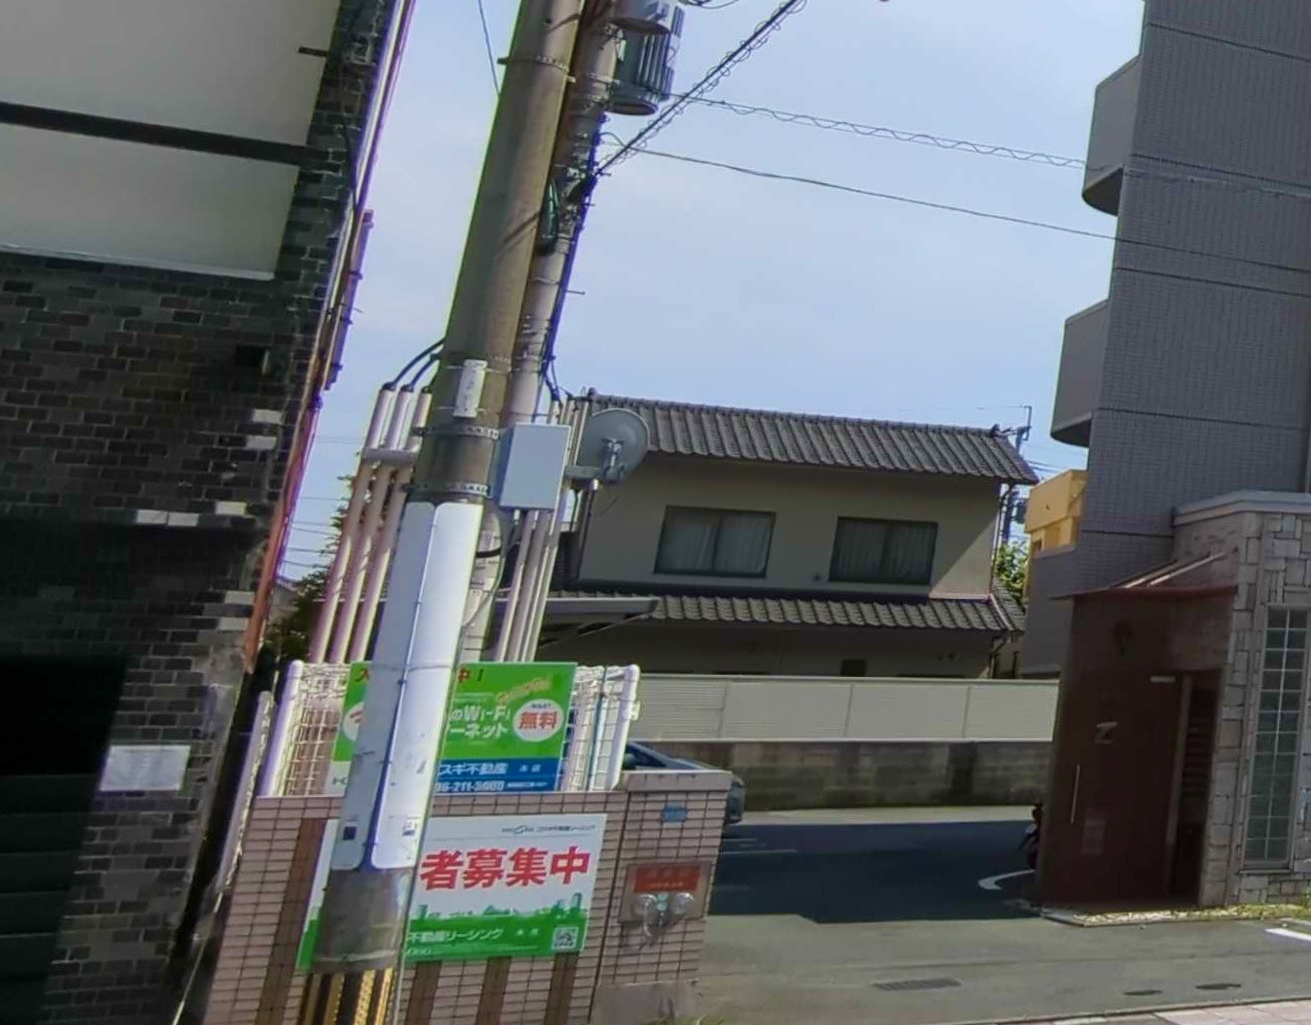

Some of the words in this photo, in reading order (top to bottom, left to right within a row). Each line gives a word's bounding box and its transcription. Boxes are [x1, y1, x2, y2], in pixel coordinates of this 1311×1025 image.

[518, 711, 558, 731] 無料
[420, 845, 592, 891] 者募集中
